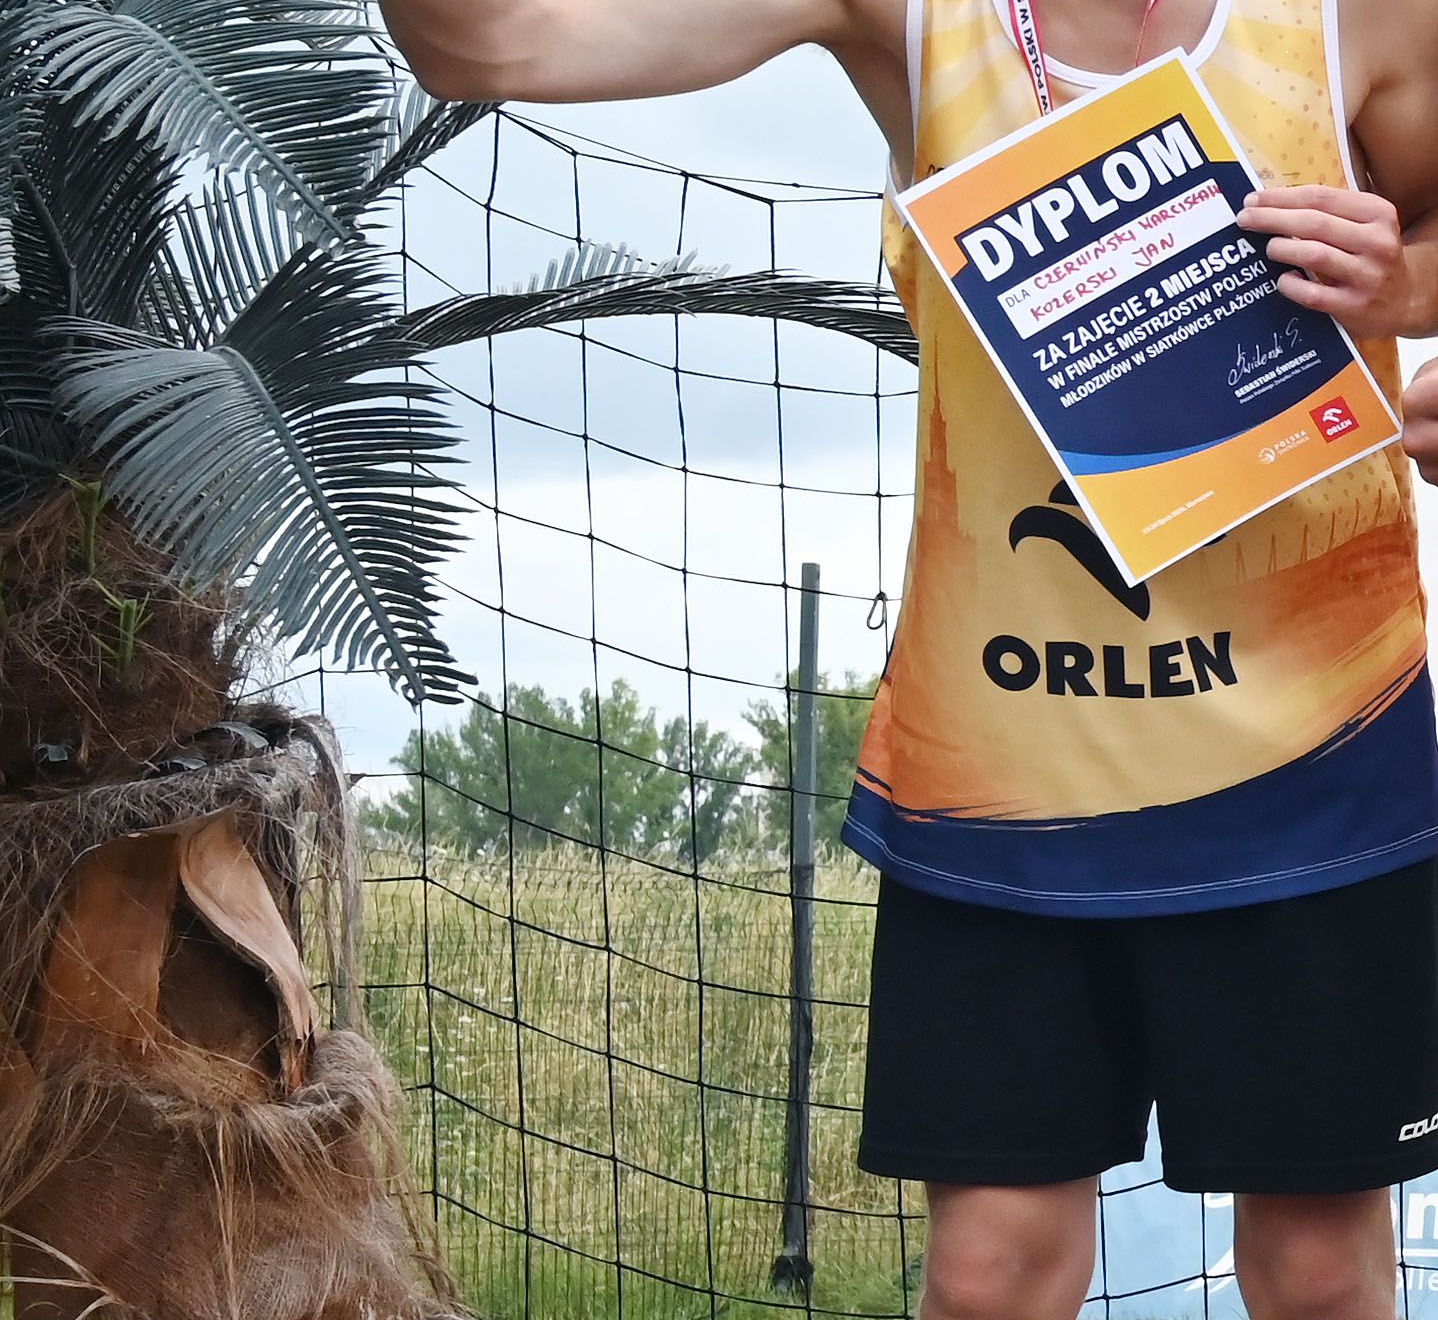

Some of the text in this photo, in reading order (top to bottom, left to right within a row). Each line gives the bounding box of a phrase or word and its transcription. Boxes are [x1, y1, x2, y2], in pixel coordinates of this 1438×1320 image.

[961, 125, 1204, 282] DYPLOM
[1130, 232, 1179, 270] JAN
[1004, 288, 1031, 307] DLA
[1031, 235, 1256, 371] ZA ZAJĘCIE 2 MIEJSCA
[1047, 258, 1268, 390] W FINALE MISTRZOSTW POLSKI
[1057, 277, 1278, 408] MŁODZIKÓW W SIATKÓWCE PLAŻOWEJ
[982, 631, 1240, 700] ORLEN
